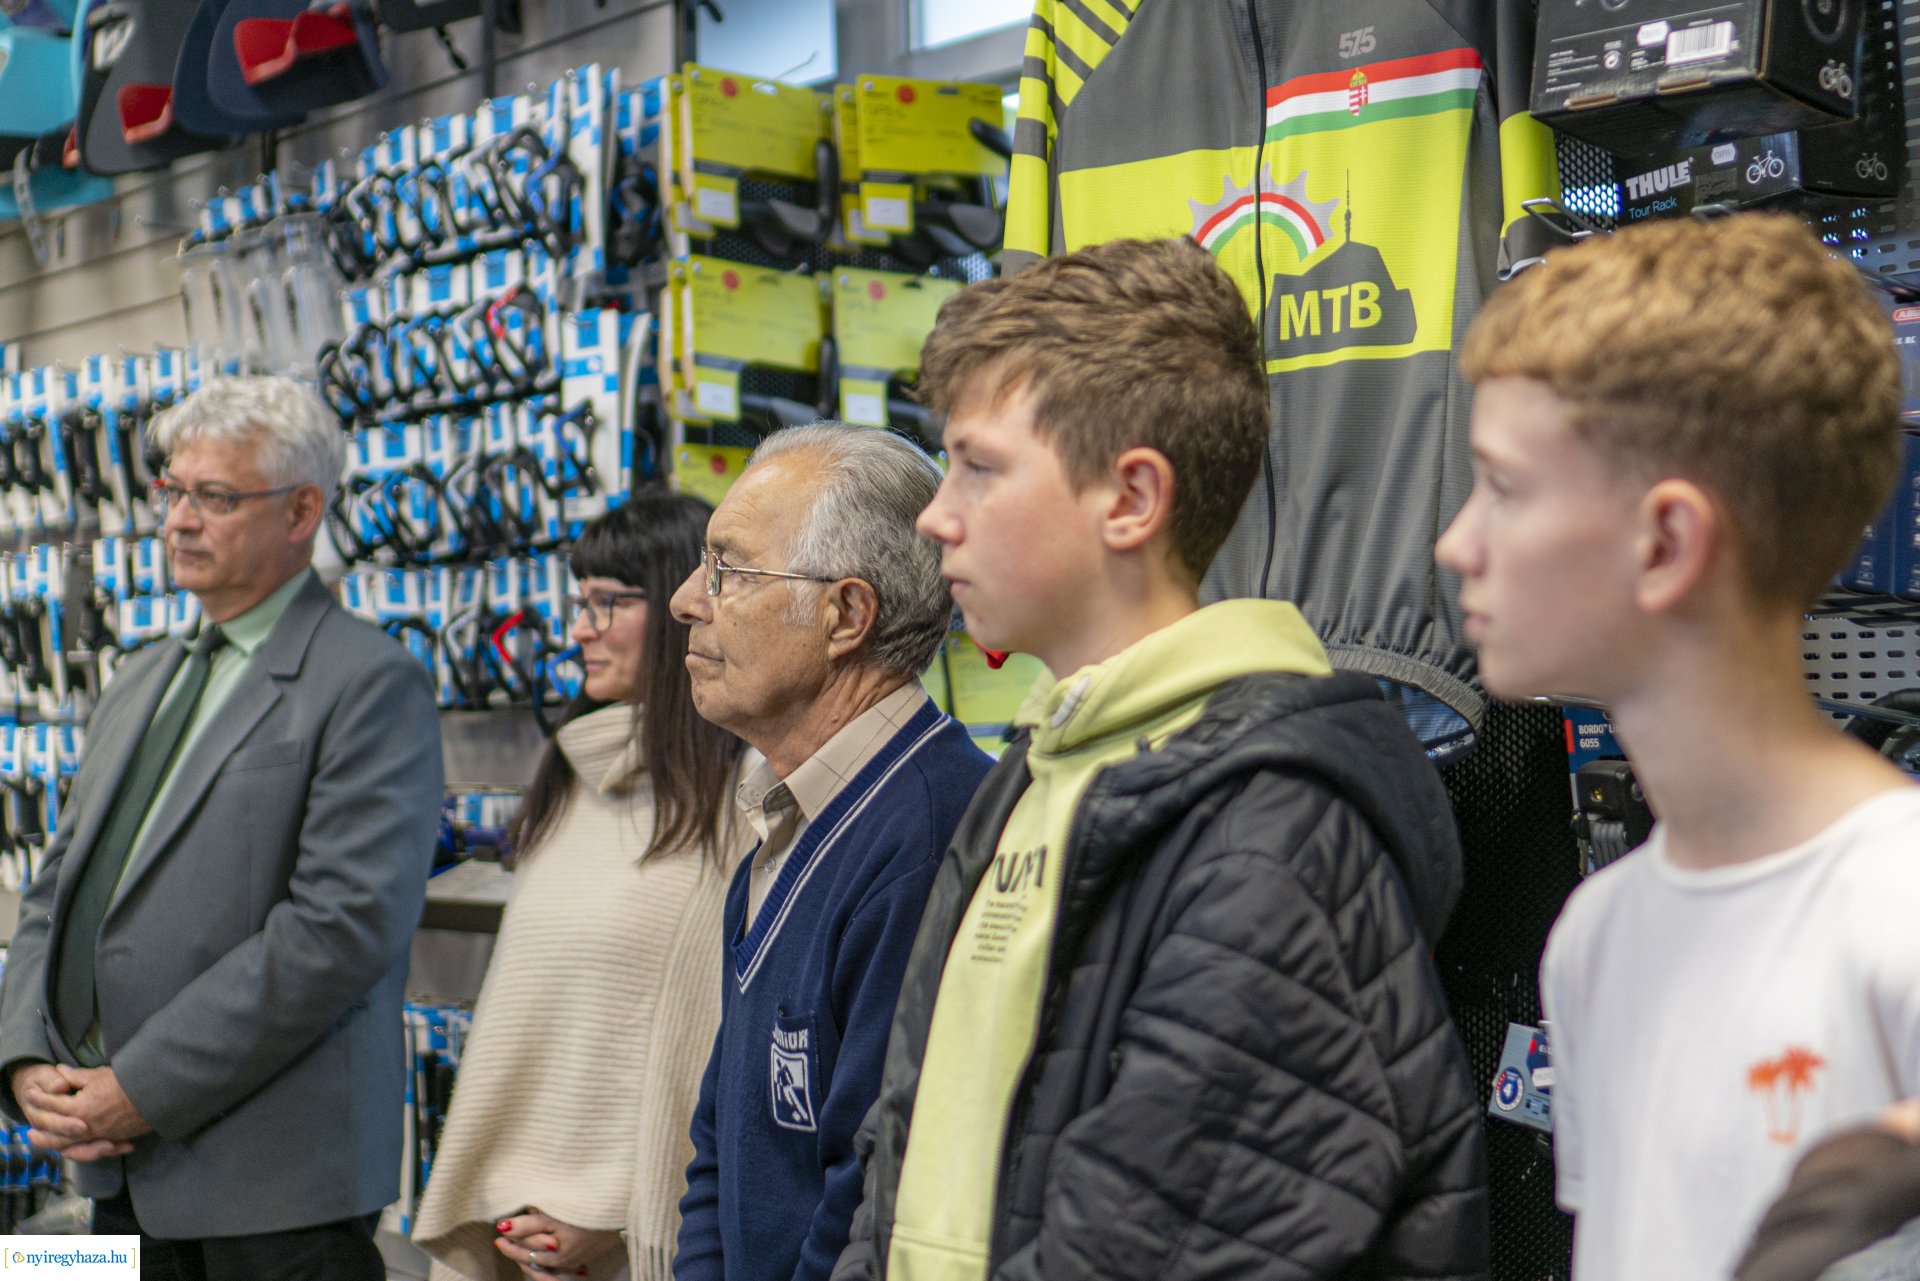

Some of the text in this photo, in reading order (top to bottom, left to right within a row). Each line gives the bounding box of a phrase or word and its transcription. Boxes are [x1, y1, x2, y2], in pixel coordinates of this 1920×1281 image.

[1629, 195, 1677, 219] Tour Rack
[1280, 281, 1382, 340] MTB
[1580, 738, 1600, 748] 6055
